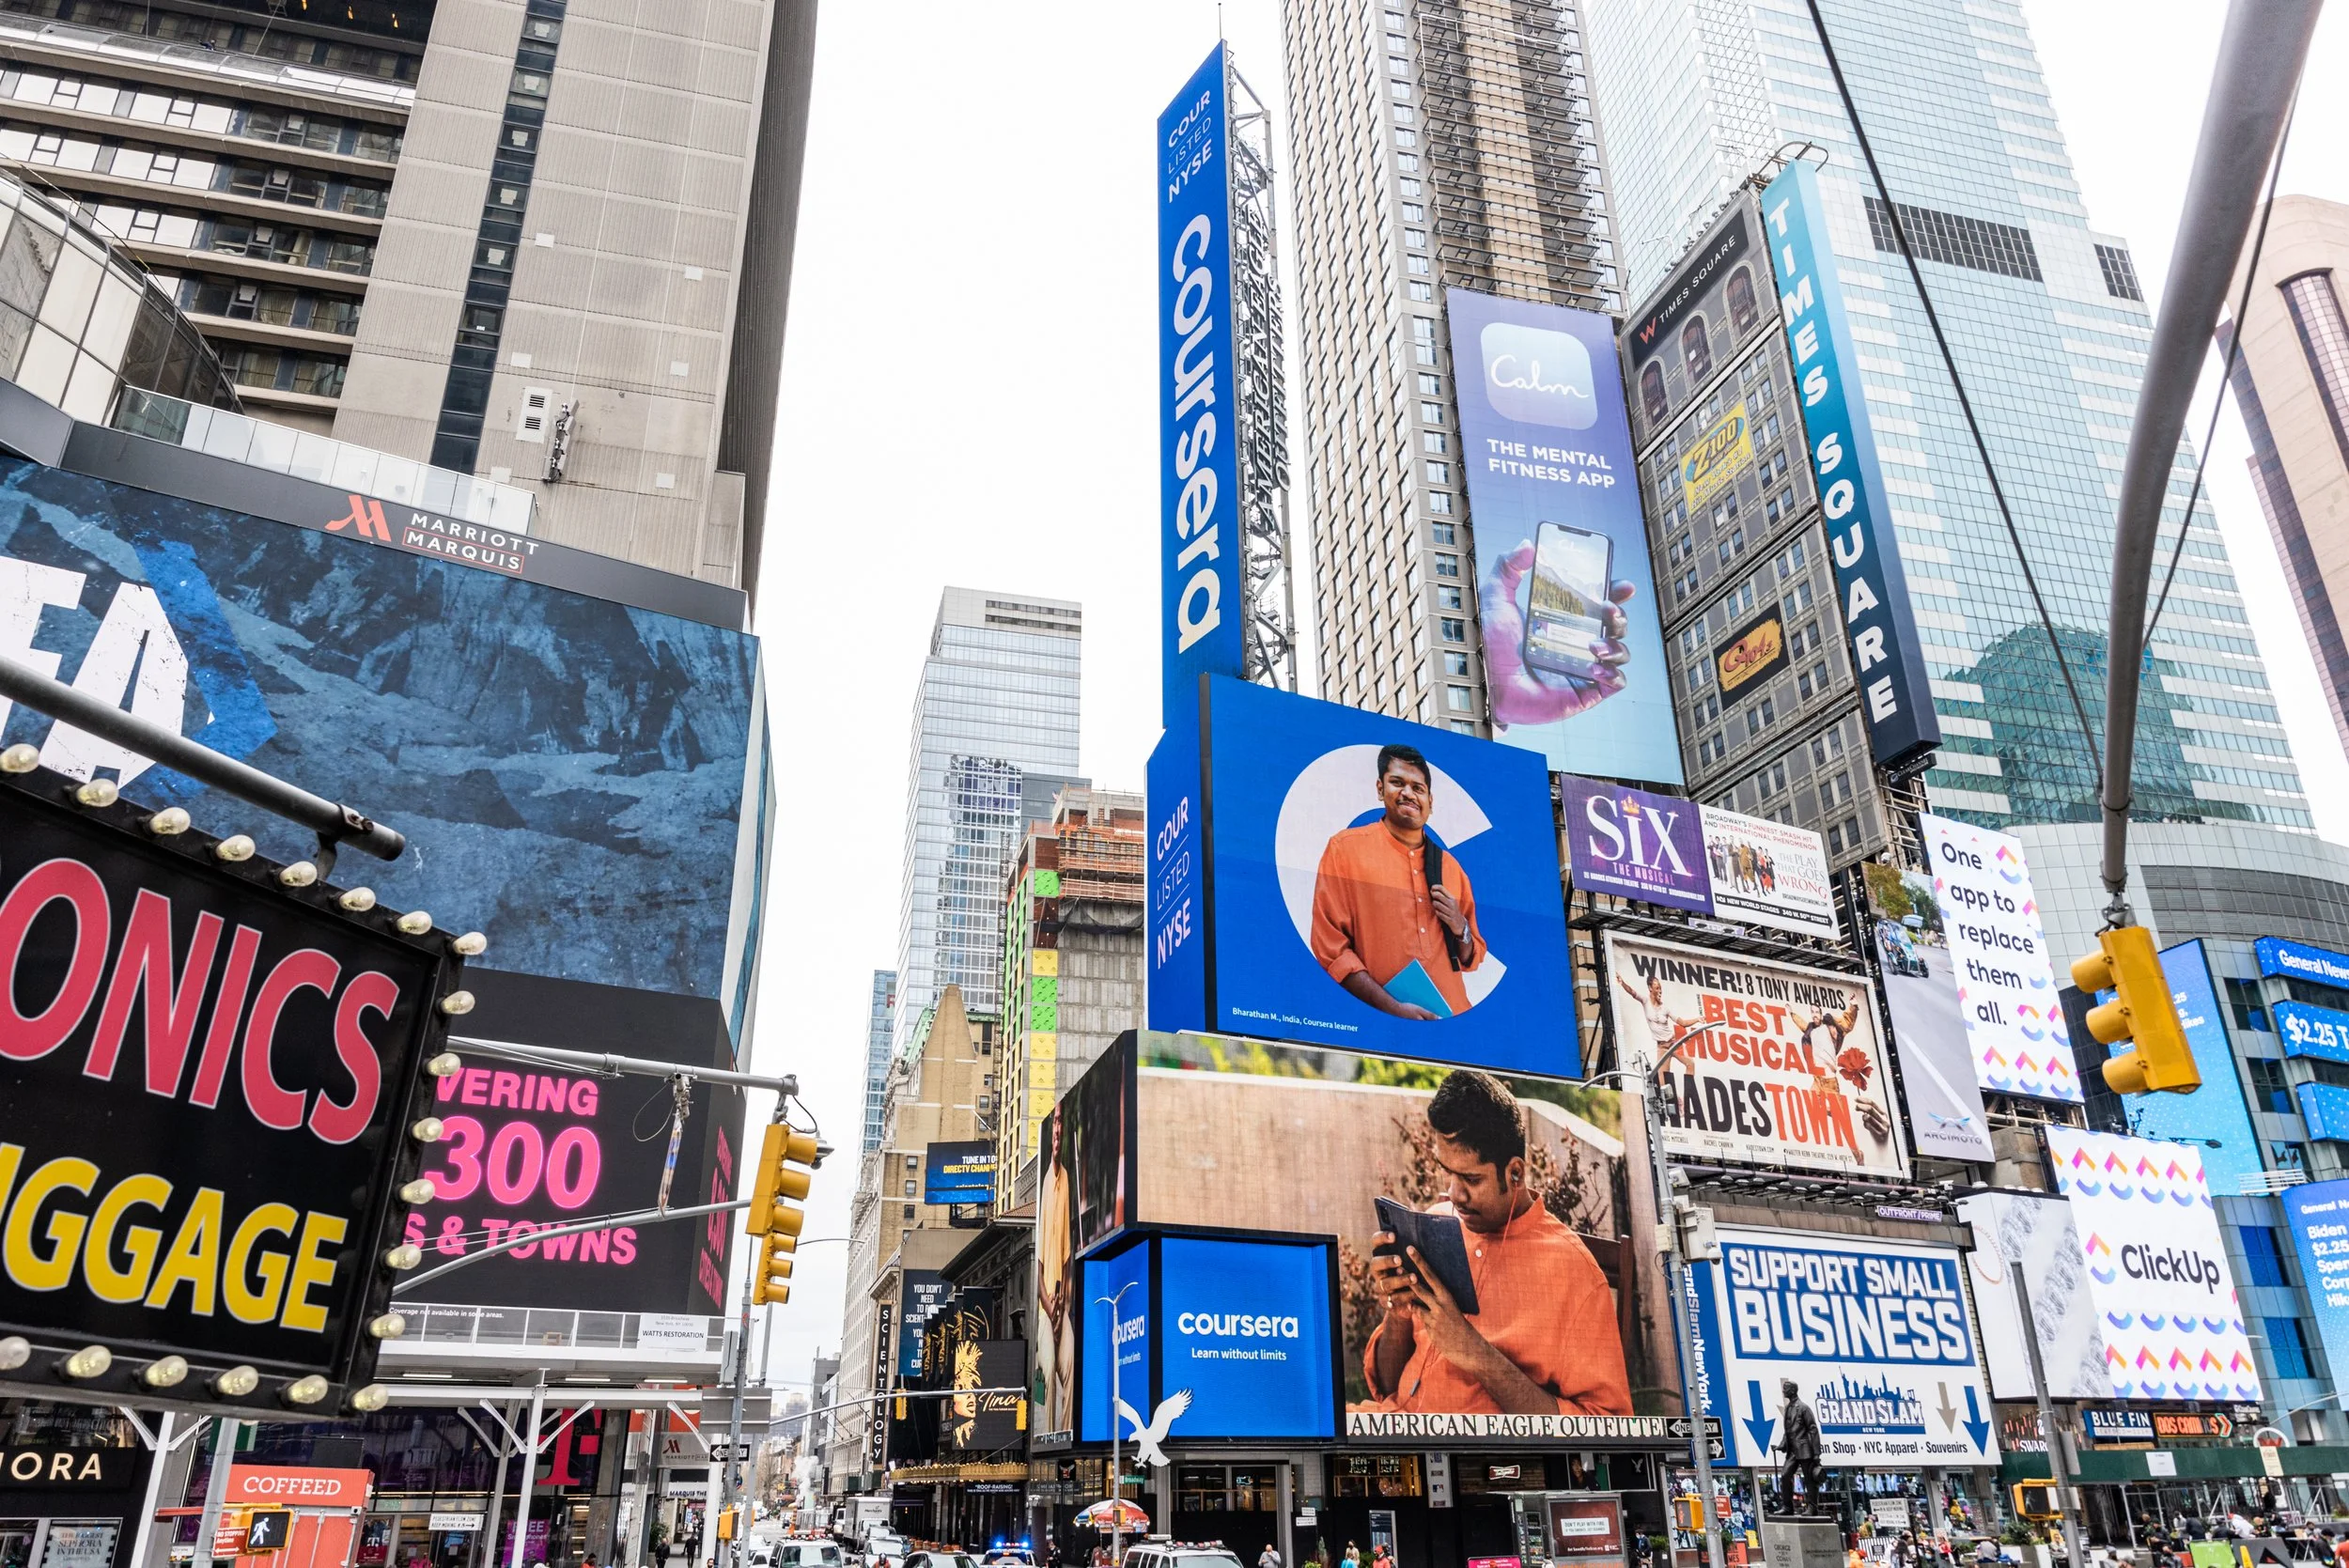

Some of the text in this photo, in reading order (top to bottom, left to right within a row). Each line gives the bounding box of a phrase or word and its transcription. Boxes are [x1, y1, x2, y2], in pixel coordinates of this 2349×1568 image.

[1168, 90, 1210, 147] COUR
[1168, 117, 1211, 174] LISTED
[1168, 139, 1212, 203] NYSE
[1659, 287, 1688, 323] TIMES
[1692, 234, 1736, 287] SQUARE
[1490, 354, 1590, 398] Calm
[1173, 214, 1221, 654] coursera
[1486, 438, 1612, 471] THE MENTAL
[1693, 417, 1739, 483] Z100
[1768, 197, 1897, 723] TIMES SQUARE
[1488, 458, 1616, 489] FITNESS APP
[412, 513, 539, 555] MARRIOTT
[406, 532, 520, 569] MARQUIS
[1157, 796, 1189, 862] COUR
[1585, 796, 1691, 877] SIX
[1705, 813, 1747, 827] BROADWAY'S
[1749, 823, 1779, 834] FUNNIEST
[1780, 831, 1801, 841] SMASH
[1719, 823, 1771, 841] INTERNATIONAL
[1772, 836, 1817, 850] PHENOMENON
[1794, 854, 1818, 867] PLAY
[1941, 842, 1983, 870] One
[1157, 850, 1190, 911] LISTED
[1612, 862, 1674, 886] THE MUSICAL
[1778, 874, 1828, 900] WRONG
[1797, 866, 1826, 881] GOES
[1727, 896, 1740, 905] NEW
[1740, 899, 1760, 909] WORLD
[1760, 904, 1780, 914] STAGES
[1811, 915, 1828, 924] STREET
[1951, 883, 2015, 914] app to
[1157, 897, 1190, 970] NYSE
[1958, 921, 2034, 954] replace
[1966, 958, 2023, 990] them
[2279, 949, 2323, 974] General
[1630, 953, 1846, 1011] WINNER! 8 TONY AWARDS
[1233, 1007, 1359, 1032] Bharathan M., India, Coursera learner
[1702, 994, 1788, 1036] BEST
[1977, 1001, 2007, 1026] all.
[2285, 1013, 2338, 1048] $2.25
[1674, 1025, 1826, 1077] MUSICAL
[1923, 1130, 1983, 1145] ARCIMOTO
[943, 1164, 970, 1173] DIRECTV
[962, 1156, 979, 1164] TUNE
[2301, 1201, 2336, 1215] General
[443, 1216, 637, 1265] & TOWNS
[2307, 1224, 2348, 1239] Biden
[1729, 1249, 1957, 1300] SUPPORT SMALL
[2121, 1244, 2220, 1295] ClickUp
[914, 1284, 942, 1294] YOU DON'T
[921, 1295, 934, 1303] NEED
[389, 1307, 418, 1315] Coverage
[917, 1304, 924, 1312] TO
[663, 1330, 705, 1339] RESTORATION
[1177, 1312, 1299, 1338] coursera
[1733, 1289, 1968, 1361] BUSINESS
[1191, 1347, 1286, 1360] Learn without limits
[978, 1391, 1021, 1412] Tina
[1349, 1414, 1553, 1436] AMERICAN EAGLE
[1674, 1423, 1690, 1432] ONE
[2092, 1411, 2151, 1427] BLUE FIN
[2156, 1415, 2177, 1435] DOS
[1833, 1441, 1968, 1455] Shop NYC Apparel Souvenirs
[0, 1452, 101, 1481] ORA
[243, 1476, 341, 1496] COFFEED
[57, 1539, 102, 1547] SEPHORA
